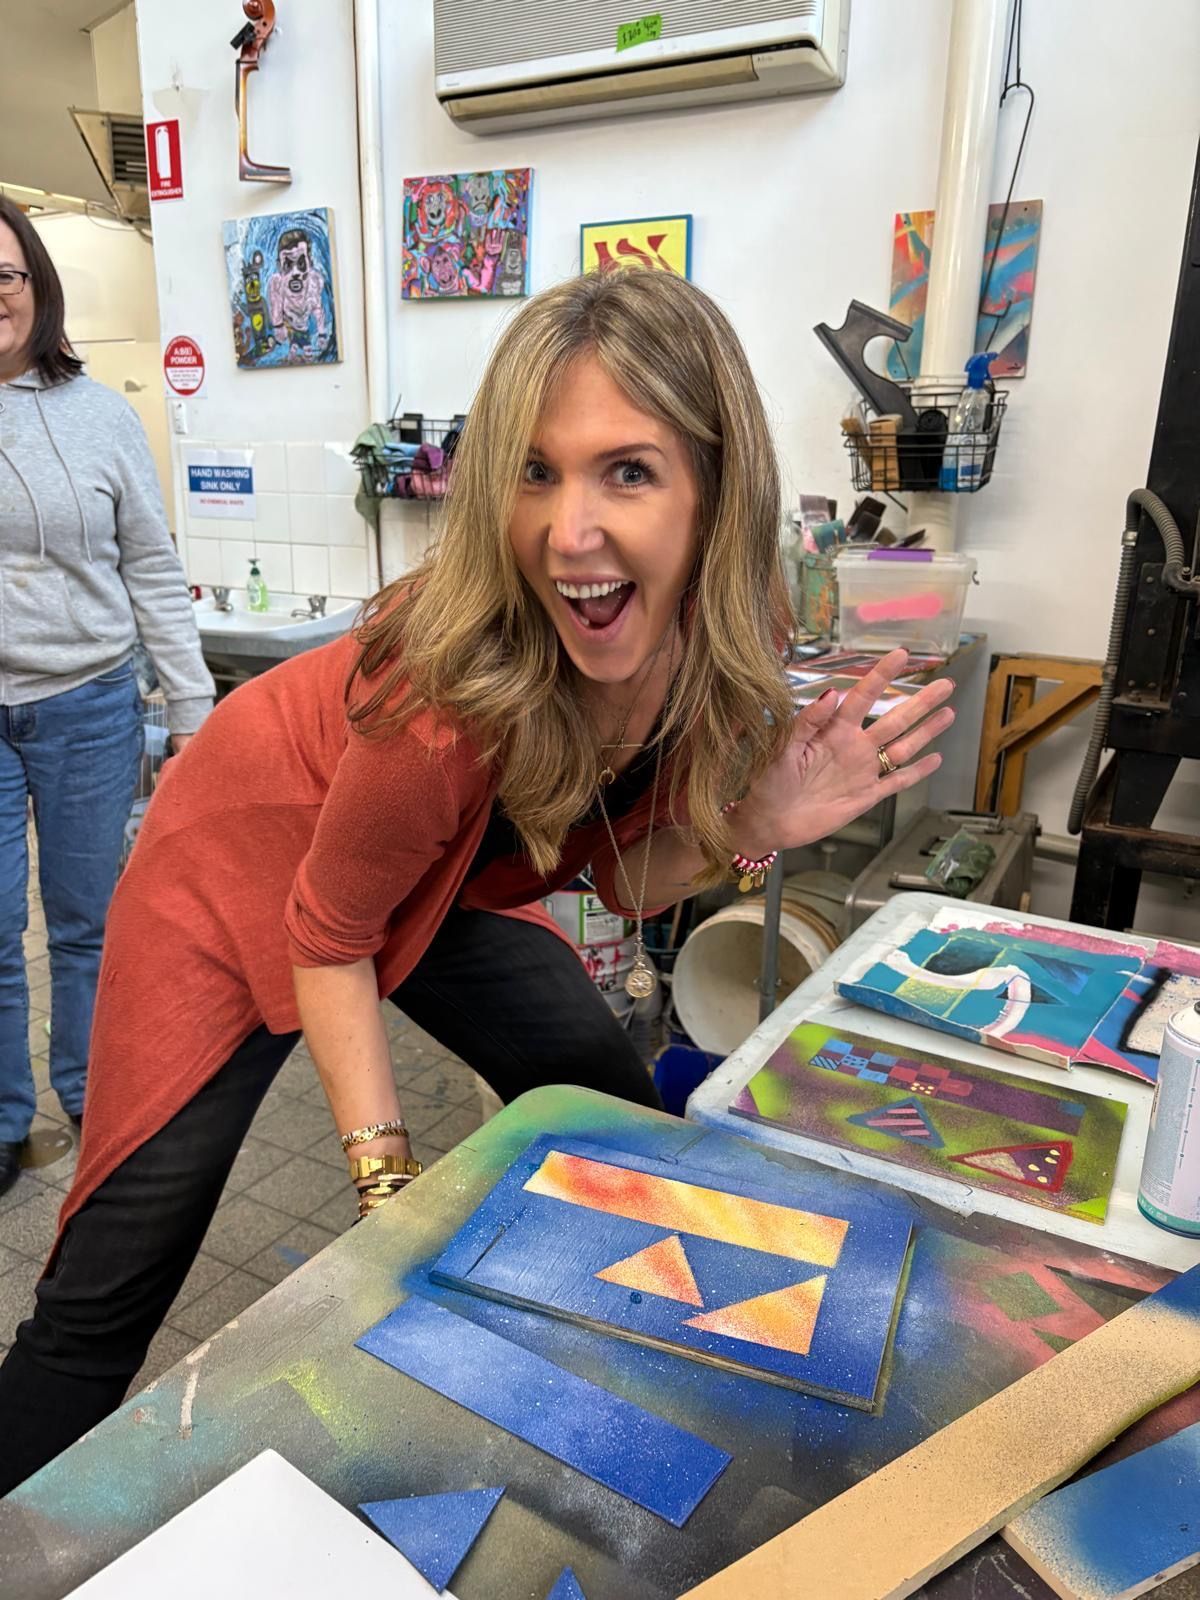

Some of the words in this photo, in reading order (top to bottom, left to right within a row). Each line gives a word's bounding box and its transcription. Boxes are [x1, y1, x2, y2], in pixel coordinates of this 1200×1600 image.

[151, 187, 182, 197] EXTINGUISHER
[170, 355, 198, 365] POWDER
[190, 467, 213, 478] HAND
[213, 467, 250, 479] WASHING
[200, 480, 219, 490] SINK
[220, 480, 241, 491] ONLY
